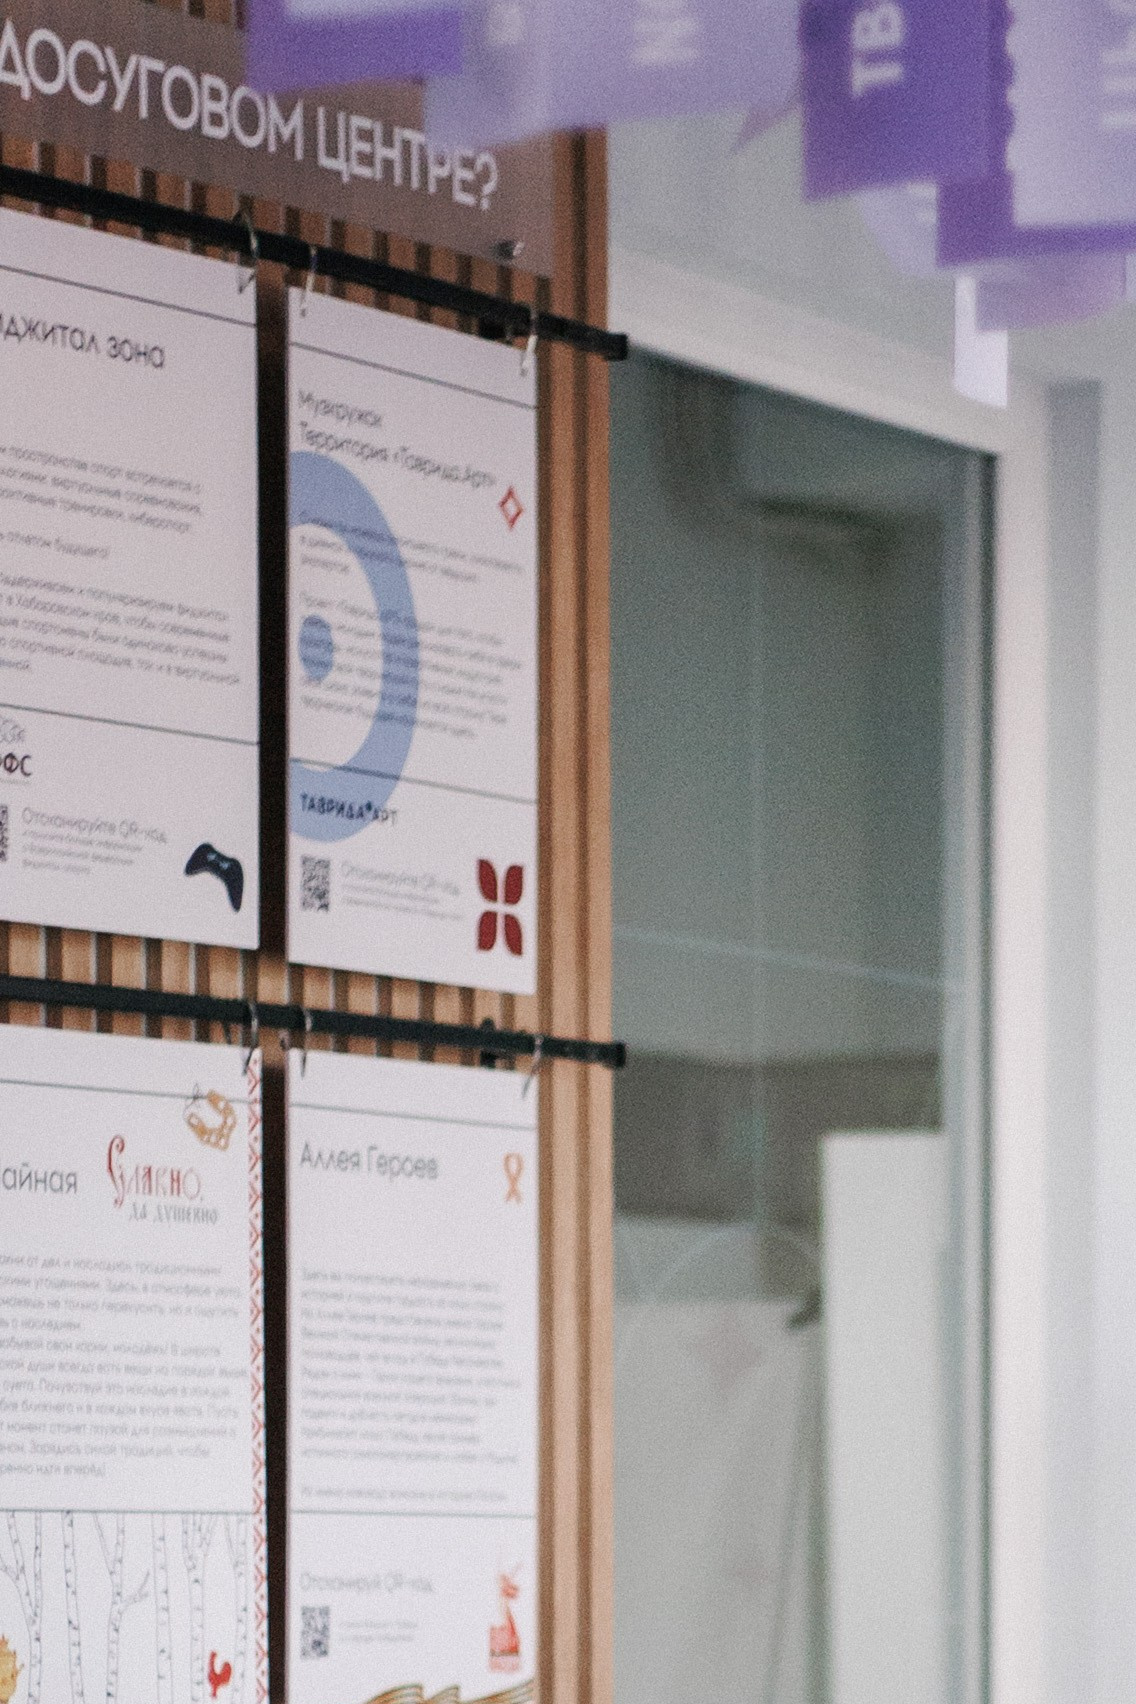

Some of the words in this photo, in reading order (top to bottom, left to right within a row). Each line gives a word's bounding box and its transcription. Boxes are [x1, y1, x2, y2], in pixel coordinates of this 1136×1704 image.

[0, 19, 303, 161] ДОСУГОВОМ
[316, 105, 499, 210] ЦЕНТРЕ?
[0, 313, 101, 355] джитал
[107, 335, 165, 369] зона
[300, 1140, 361, 1172] Аллея
[366, 1144, 438, 1183] Героев
